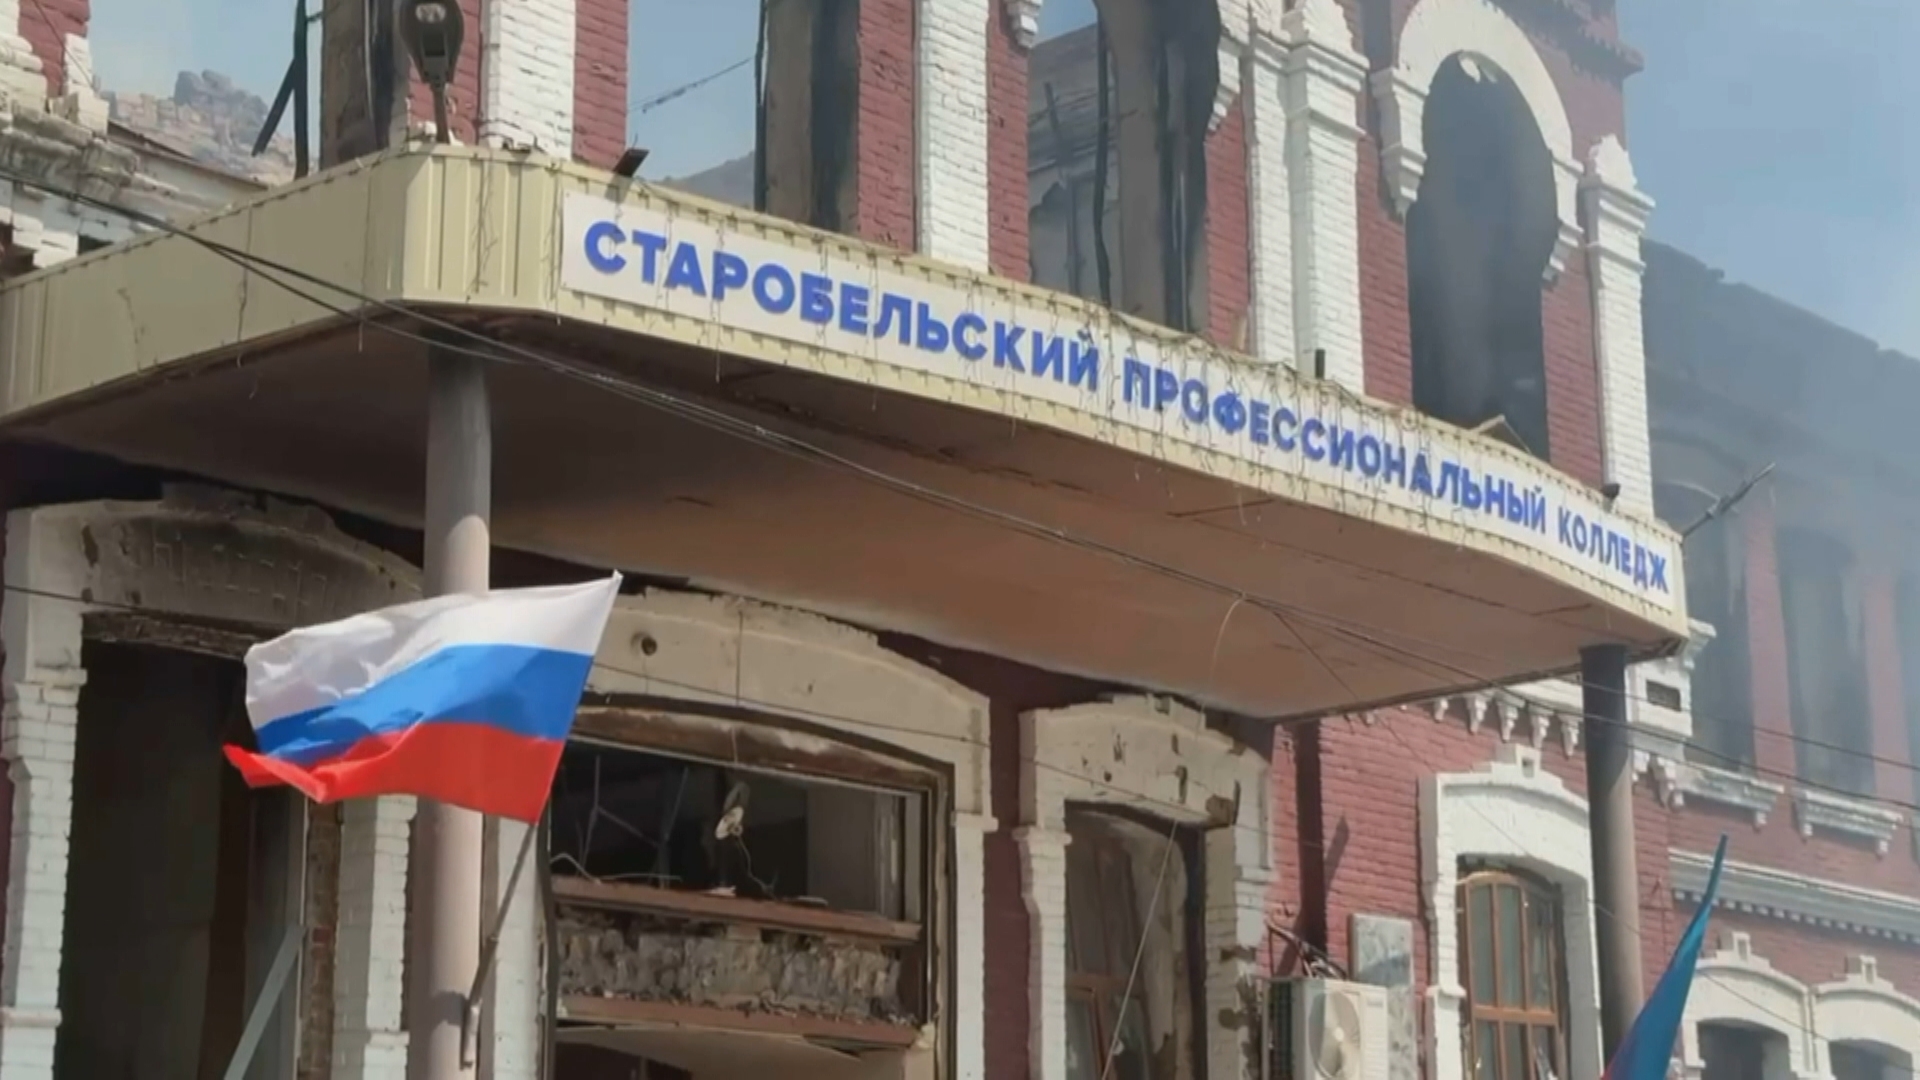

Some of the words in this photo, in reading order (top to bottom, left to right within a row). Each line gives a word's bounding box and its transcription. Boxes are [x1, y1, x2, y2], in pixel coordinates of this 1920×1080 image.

[584, 221, 1099, 391] СТАРОБЕЛЬСКИЙ
[1123, 358, 1546, 534] ПРОФЕССИОНАЛЬНЫЙ
[1557, 506, 1669, 593] КОЛЛЕДЖ
